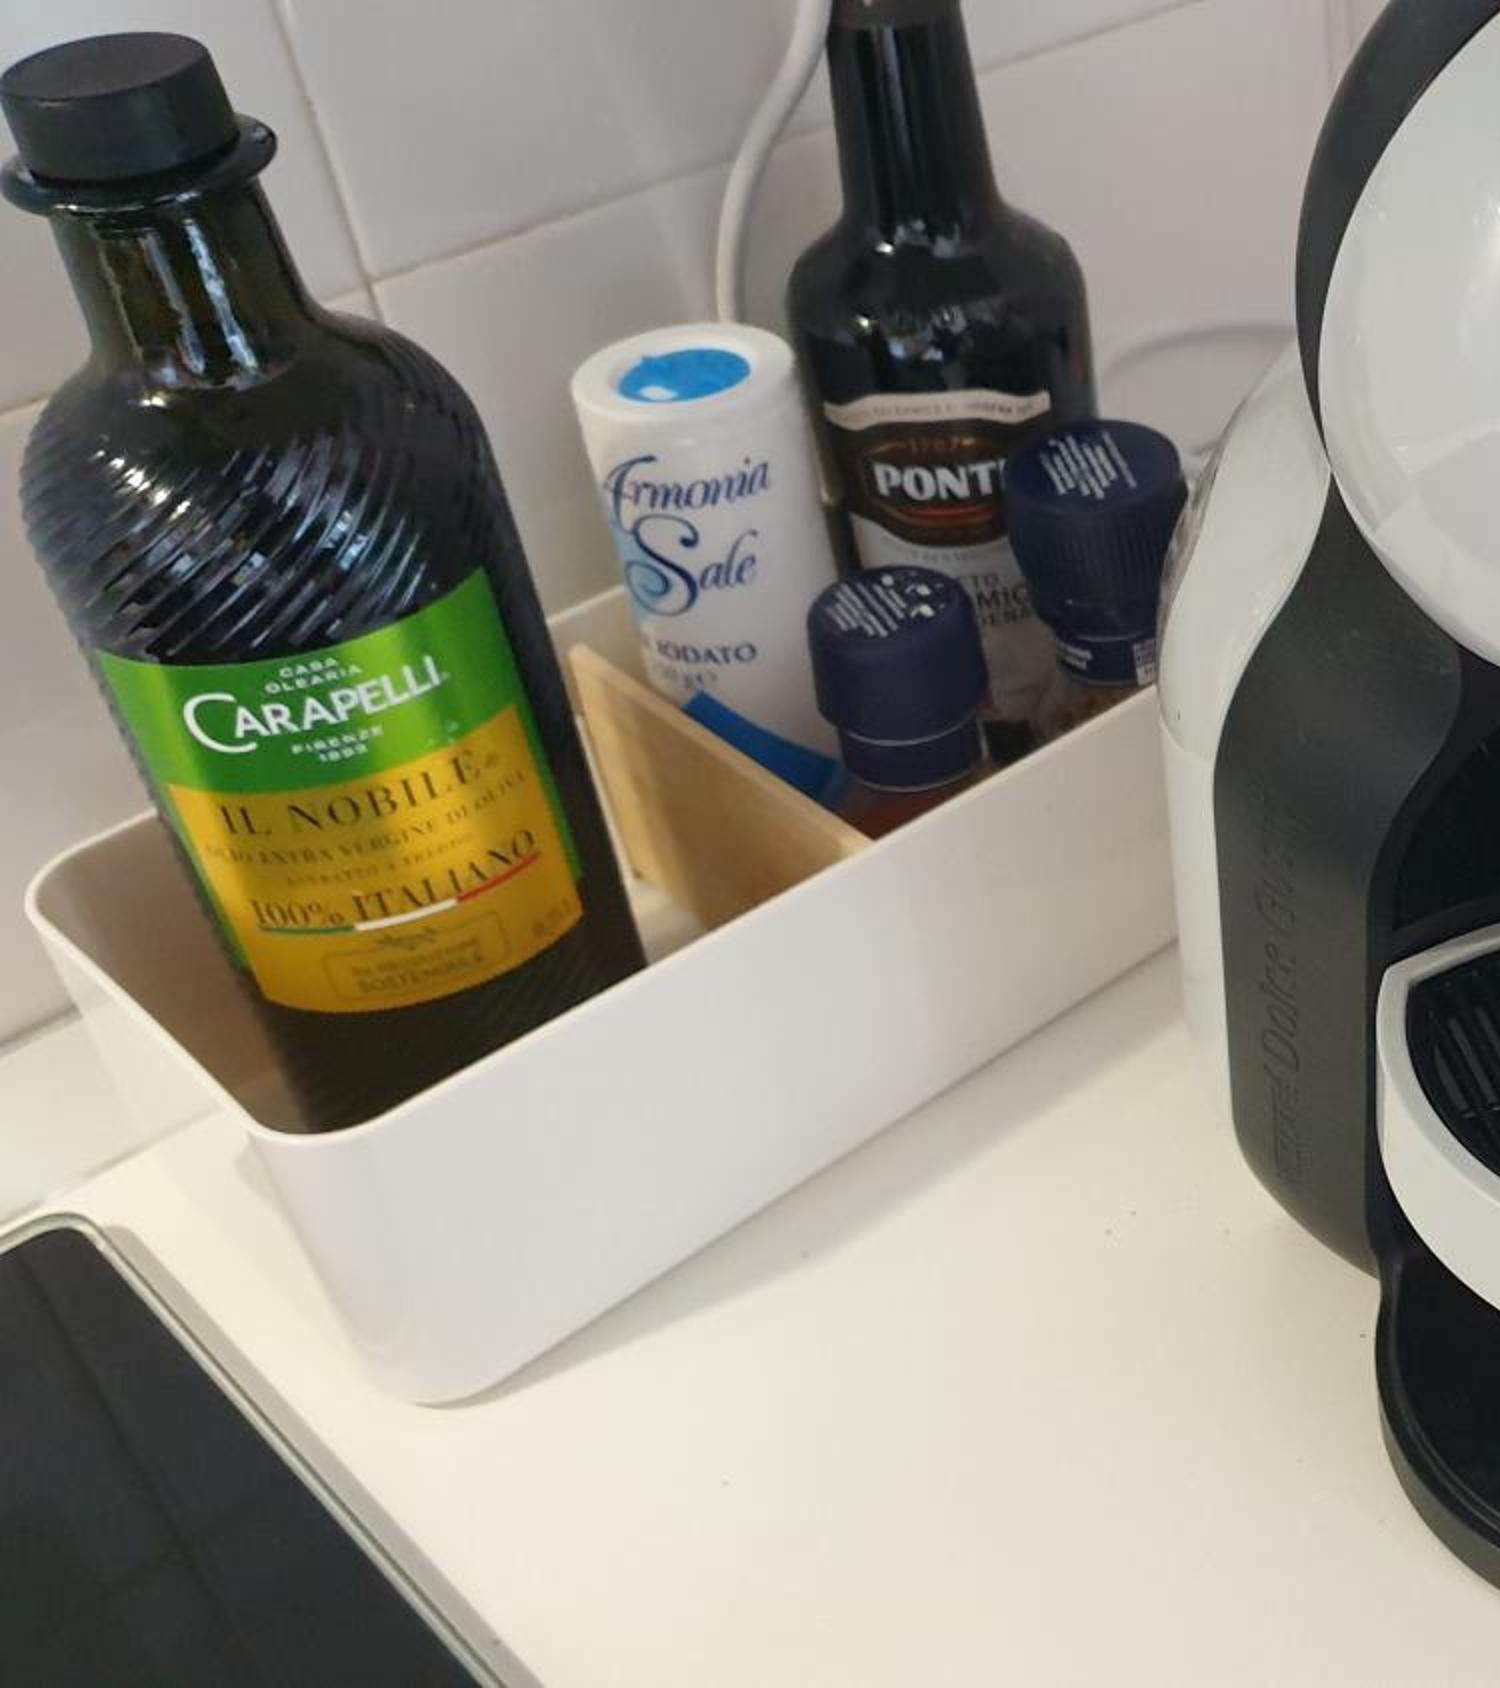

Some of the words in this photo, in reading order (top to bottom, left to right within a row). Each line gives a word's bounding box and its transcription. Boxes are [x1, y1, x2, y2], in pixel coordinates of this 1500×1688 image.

[625, 513, 758, 616] Sale
[183, 655, 442, 753] CARAPELLI
[280, 658, 339, 679] CASA
[220, 804, 272, 835] IL
[288, 749, 481, 830] NOBILE
[252, 900, 344, 926] 100%
[352, 830, 535, 922] ITALIANO
